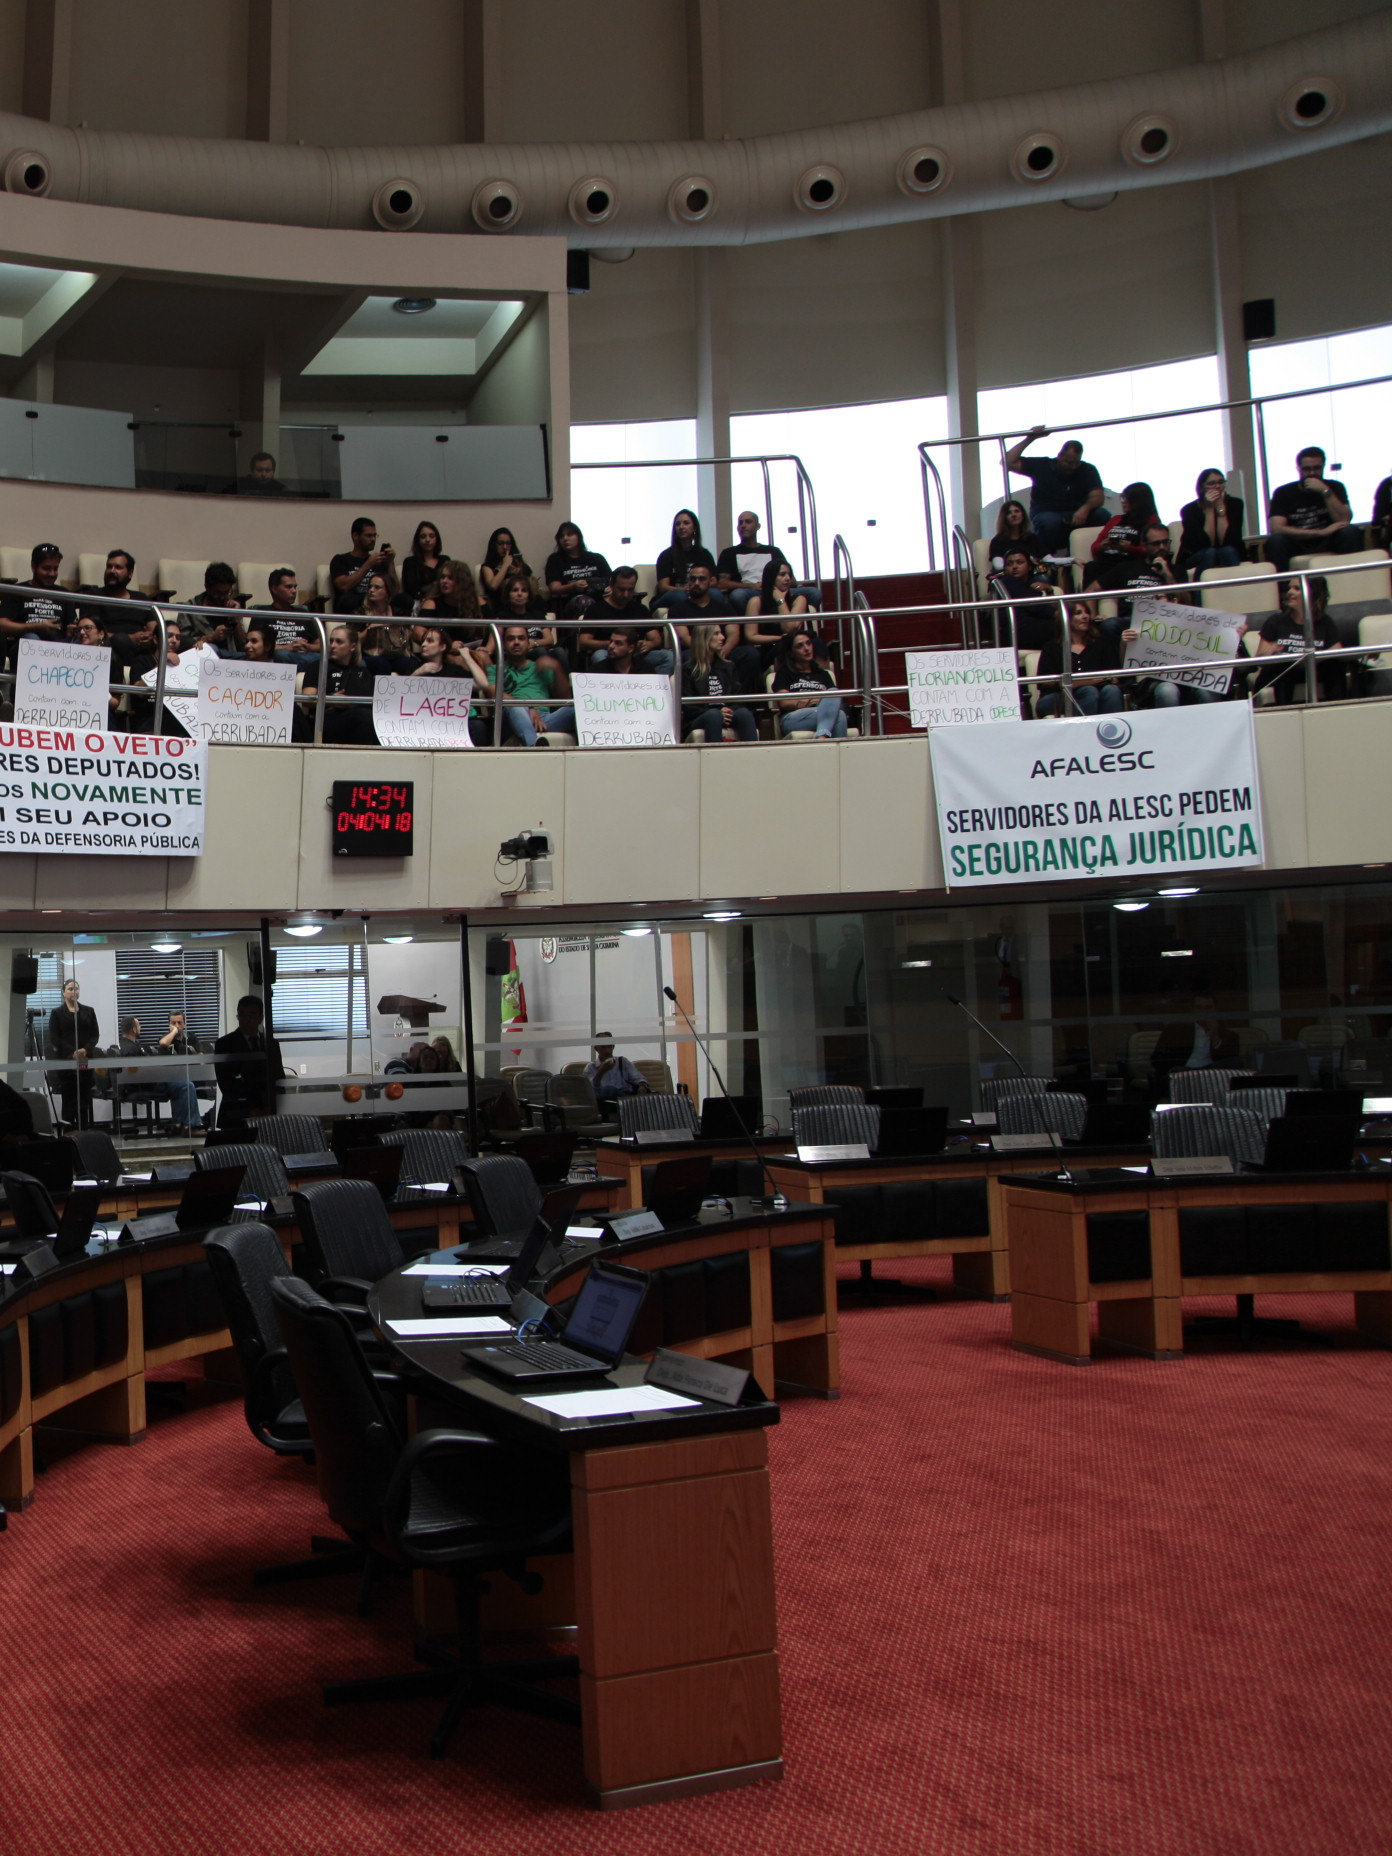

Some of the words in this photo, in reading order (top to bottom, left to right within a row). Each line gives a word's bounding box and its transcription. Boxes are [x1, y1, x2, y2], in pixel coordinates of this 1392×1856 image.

[1166, 626, 1192, 647] DO
[1193, 632, 1230, 655] SUL
[928, 652, 990, 668] SERVIDORES
[994, 651, 1011, 665] DE
[28, 664, 99, 689] CHAPECÓ
[280, 671, 294, 682] de
[401, 677, 471, 696] SERVIDORES
[908, 667, 1014, 688] FLORIANÓPOLIS
[208, 686, 283, 712] CAÇADOR
[581, 693, 665, 713] BLUMENAU
[912, 689, 958, 705] CONTAM
[966, 687, 993, 703] COM
[999, 687, 1010, 702] A
[374, 699, 391, 714] DE
[399, 696, 470, 718] LAGES
[910, 707, 985, 726] DERRUBADA
[16, 707, 101, 730] DERRUBADA
[376, 718, 427, 736] CONTAM
[430, 719, 453, 736] COM
[458, 720, 466, 737] A
[84, 733, 105, 753] O
[200, 722, 287, 743] DERRUBADA
[581, 730, 673, 746] DERRUBADA
[47, 756, 200, 781] DEPUTADOS!
[1030, 750, 1155, 779] AFALESC
[31, 782, 203, 806] NOVAMENTE
[351, 785, 408, 810] 14:34
[16, 808, 72, 826] SEU
[82, 811, 172, 828] APOIO
[946, 802, 1069, 834] SERVIDORES
[1074, 800, 1102, 824] DA
[1108, 793, 1173, 822] ALESC
[1179, 787, 1252, 816] PEDEM
[20, 831, 41, 845] DA
[45, 832, 137, 848] DEFENSORIA
[141, 832, 200, 849] PÚBLICA
[950, 834, 1118, 877] SEGURANÇA
[1127, 821, 1257, 866] JURÍDICA
